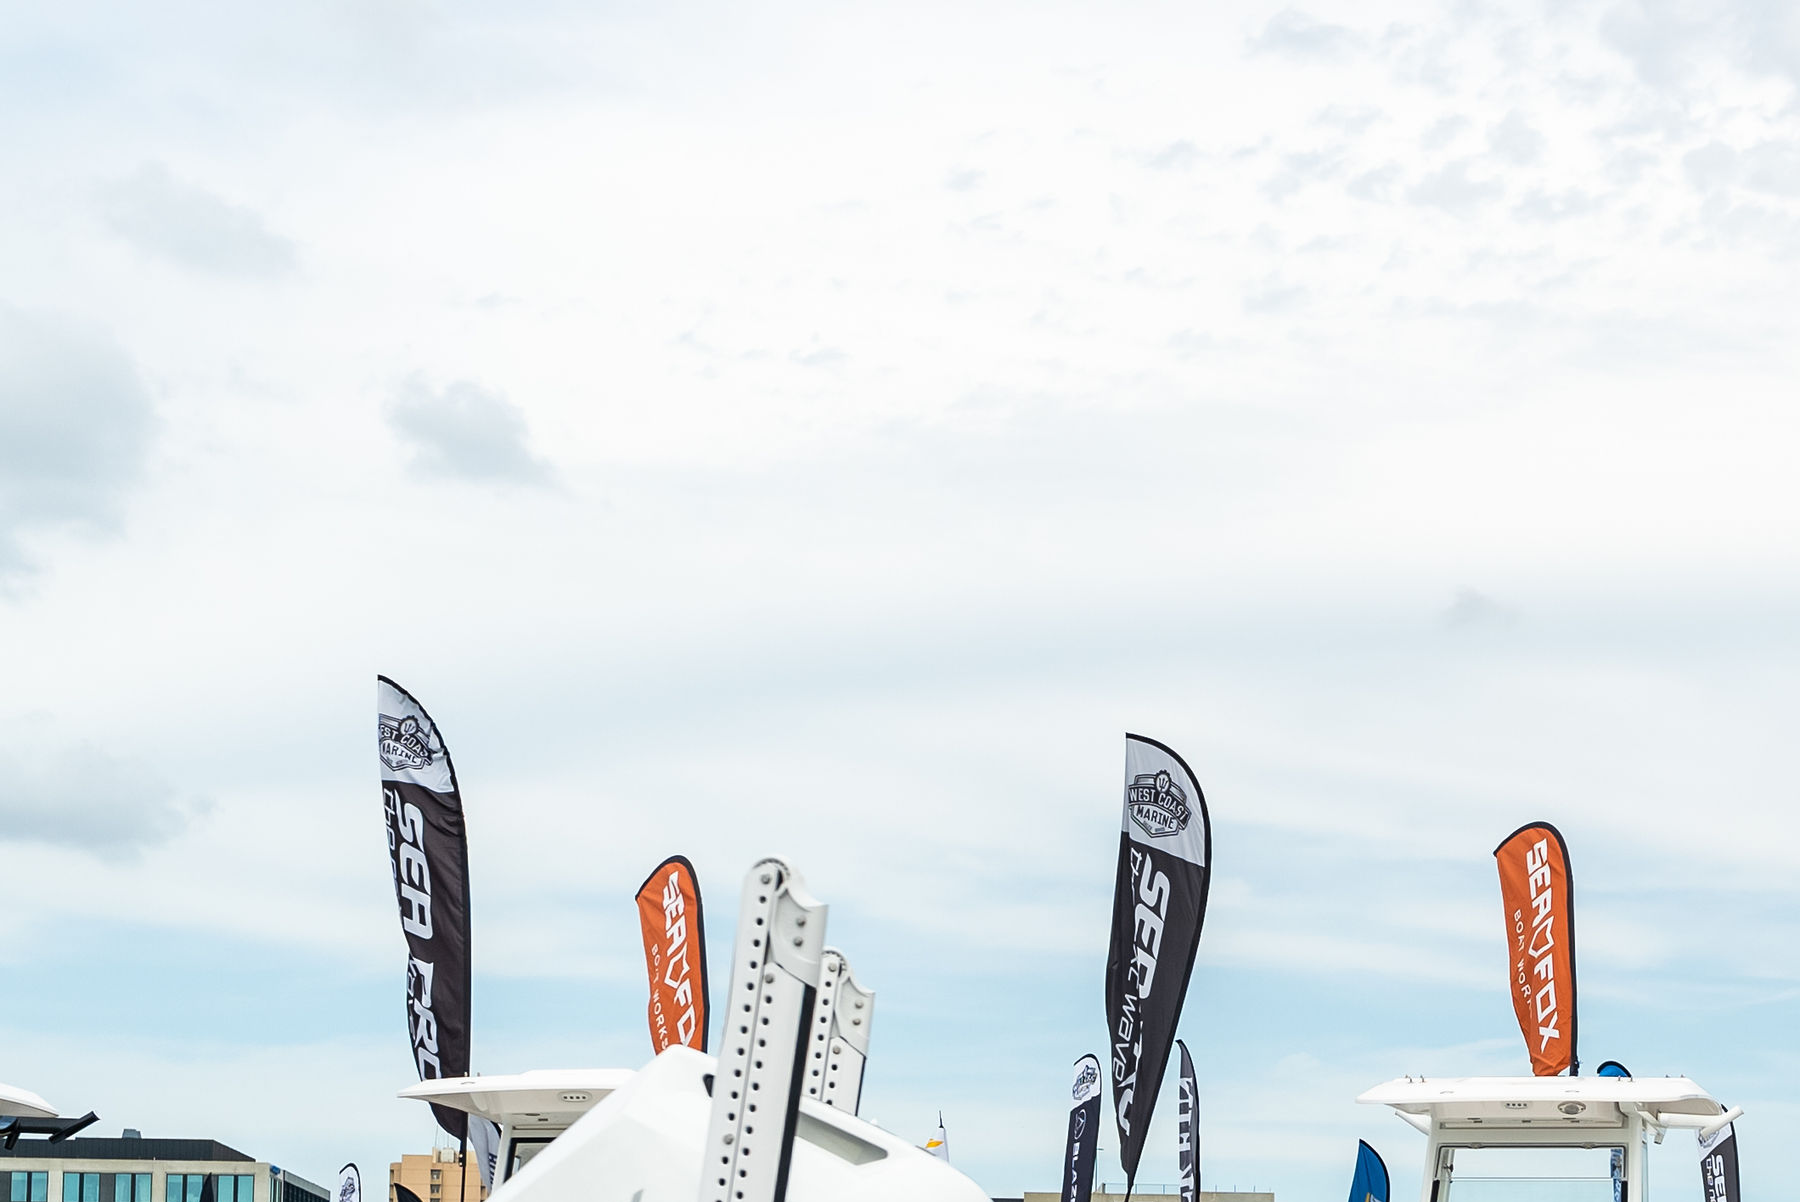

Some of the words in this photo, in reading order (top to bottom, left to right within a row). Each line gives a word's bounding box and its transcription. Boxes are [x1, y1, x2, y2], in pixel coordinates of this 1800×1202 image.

[1129, 787, 1156, 802] WEST
[1157, 792, 1189, 821] COAST
[1136, 804, 1175, 830] MARINE
[394, 787, 433, 940] SEA
[1112, 993, 1138, 1083] wave
